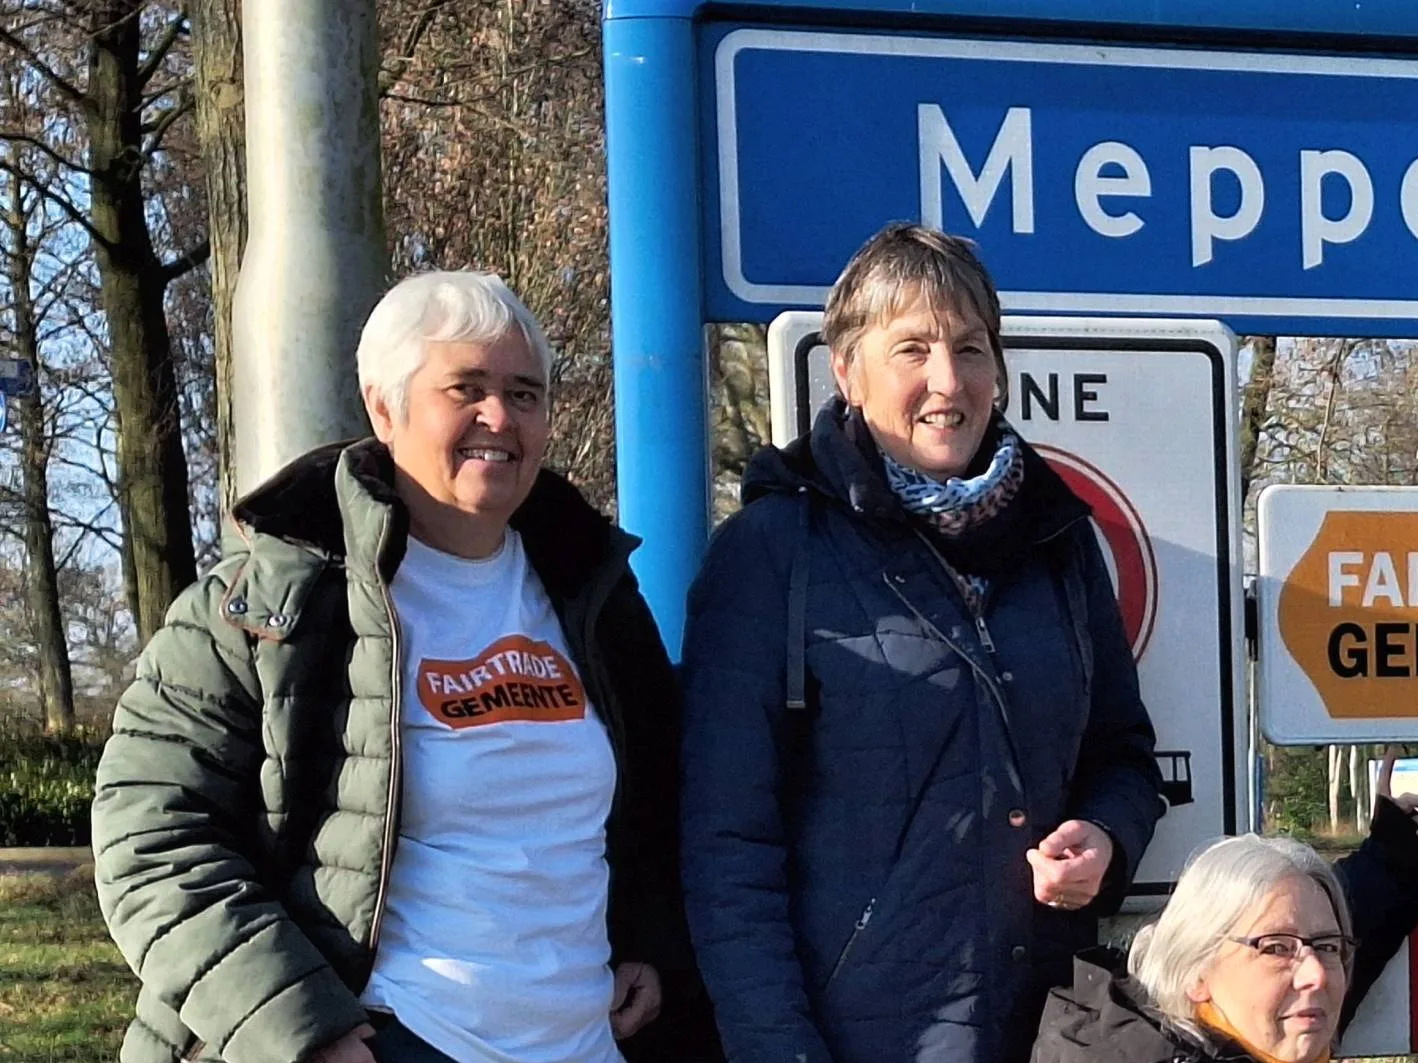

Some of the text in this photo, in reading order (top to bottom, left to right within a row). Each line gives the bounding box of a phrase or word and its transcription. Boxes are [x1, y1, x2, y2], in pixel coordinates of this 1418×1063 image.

[1019, 372, 1109, 421] NE
[426, 650, 562, 694] FAIRTRADE
[440, 682, 578, 718] GEMEENTE
